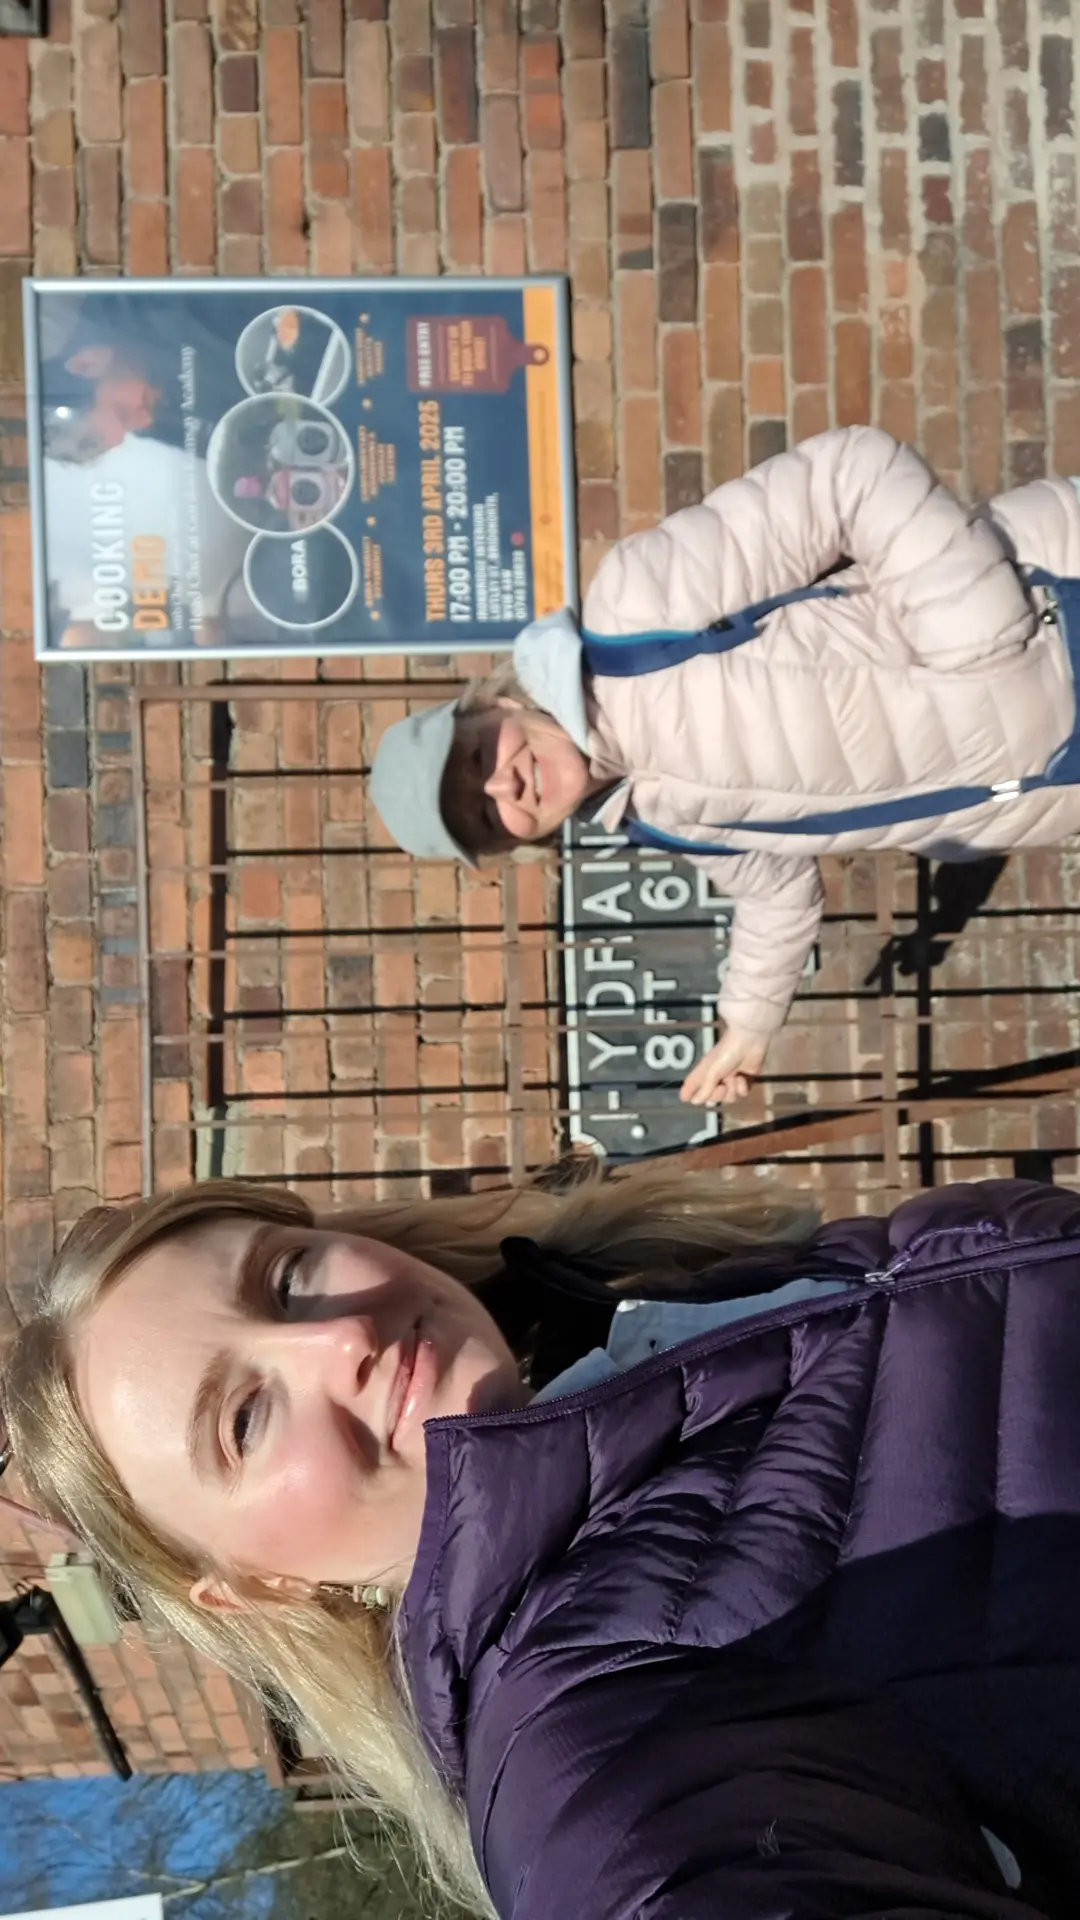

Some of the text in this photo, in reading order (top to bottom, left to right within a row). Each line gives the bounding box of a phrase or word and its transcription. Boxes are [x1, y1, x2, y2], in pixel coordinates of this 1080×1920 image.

[176, 344, 198, 410] Academy
[416, 322, 432, 388] FREE ENTRY
[443, 426, 466, 454] PM
[418, 400, 446, 620] THURS 3RD APRIL 2025
[445, 458, 468, 519] 20:00
[90, 481, 129, 631] COOKING
[184, 550, 200, 588] Chef
[186, 535, 199, 549] at
[290, 540, 306, 591] BORA
[446, 535, 469, 564] PM
[131, 535, 168, 630] DEMO
[186, 590, 203, 631] Head
[448, 568, 471, 621] 17:00
[580, 822, 640, 1121] HYDRAN
